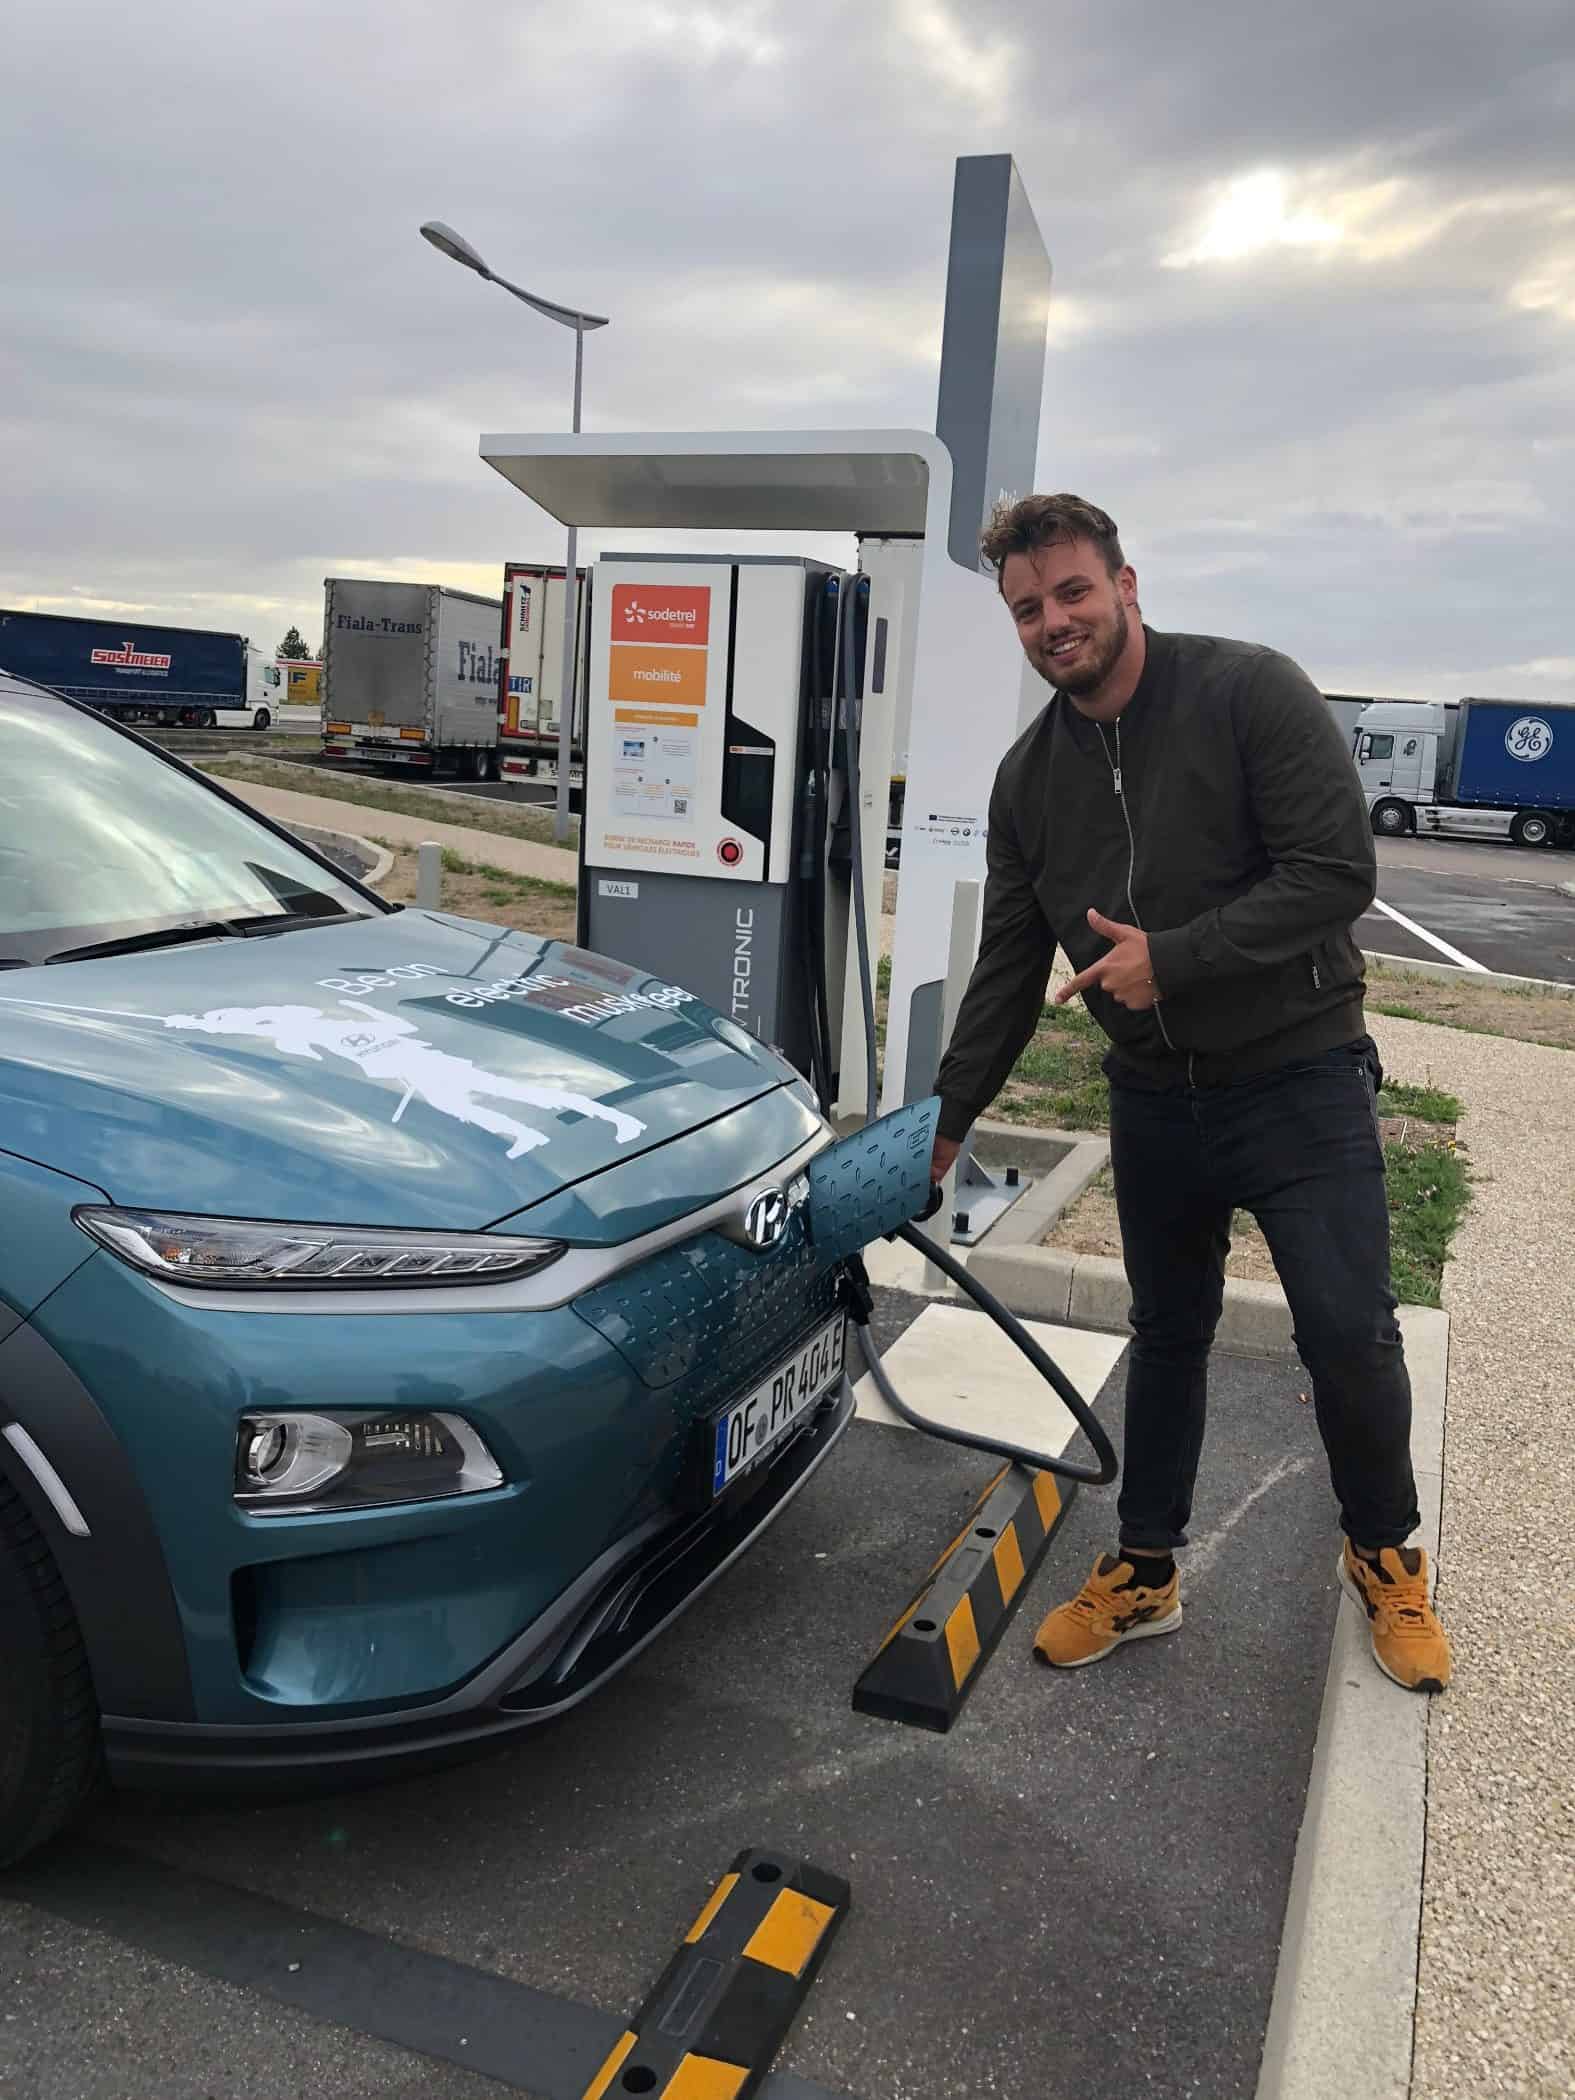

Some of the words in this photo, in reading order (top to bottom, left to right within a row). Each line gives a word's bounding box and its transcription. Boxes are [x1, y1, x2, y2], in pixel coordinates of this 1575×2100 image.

[336, 614, 423, 634] Fiala-Trans
[647, 607, 697, 622] sodetrel
[511, 677, 532, 693] TIR
[633, 668, 682, 682] mobilité
[314, 975, 397, 995] Be
[446, 972, 570, 1008] electric
[557, 985, 700, 1024] musketeer
[728, 1397, 758, 1469] OF
[770, 1364, 796, 1431] PR
[798, 1319, 843, 1401] 404E
